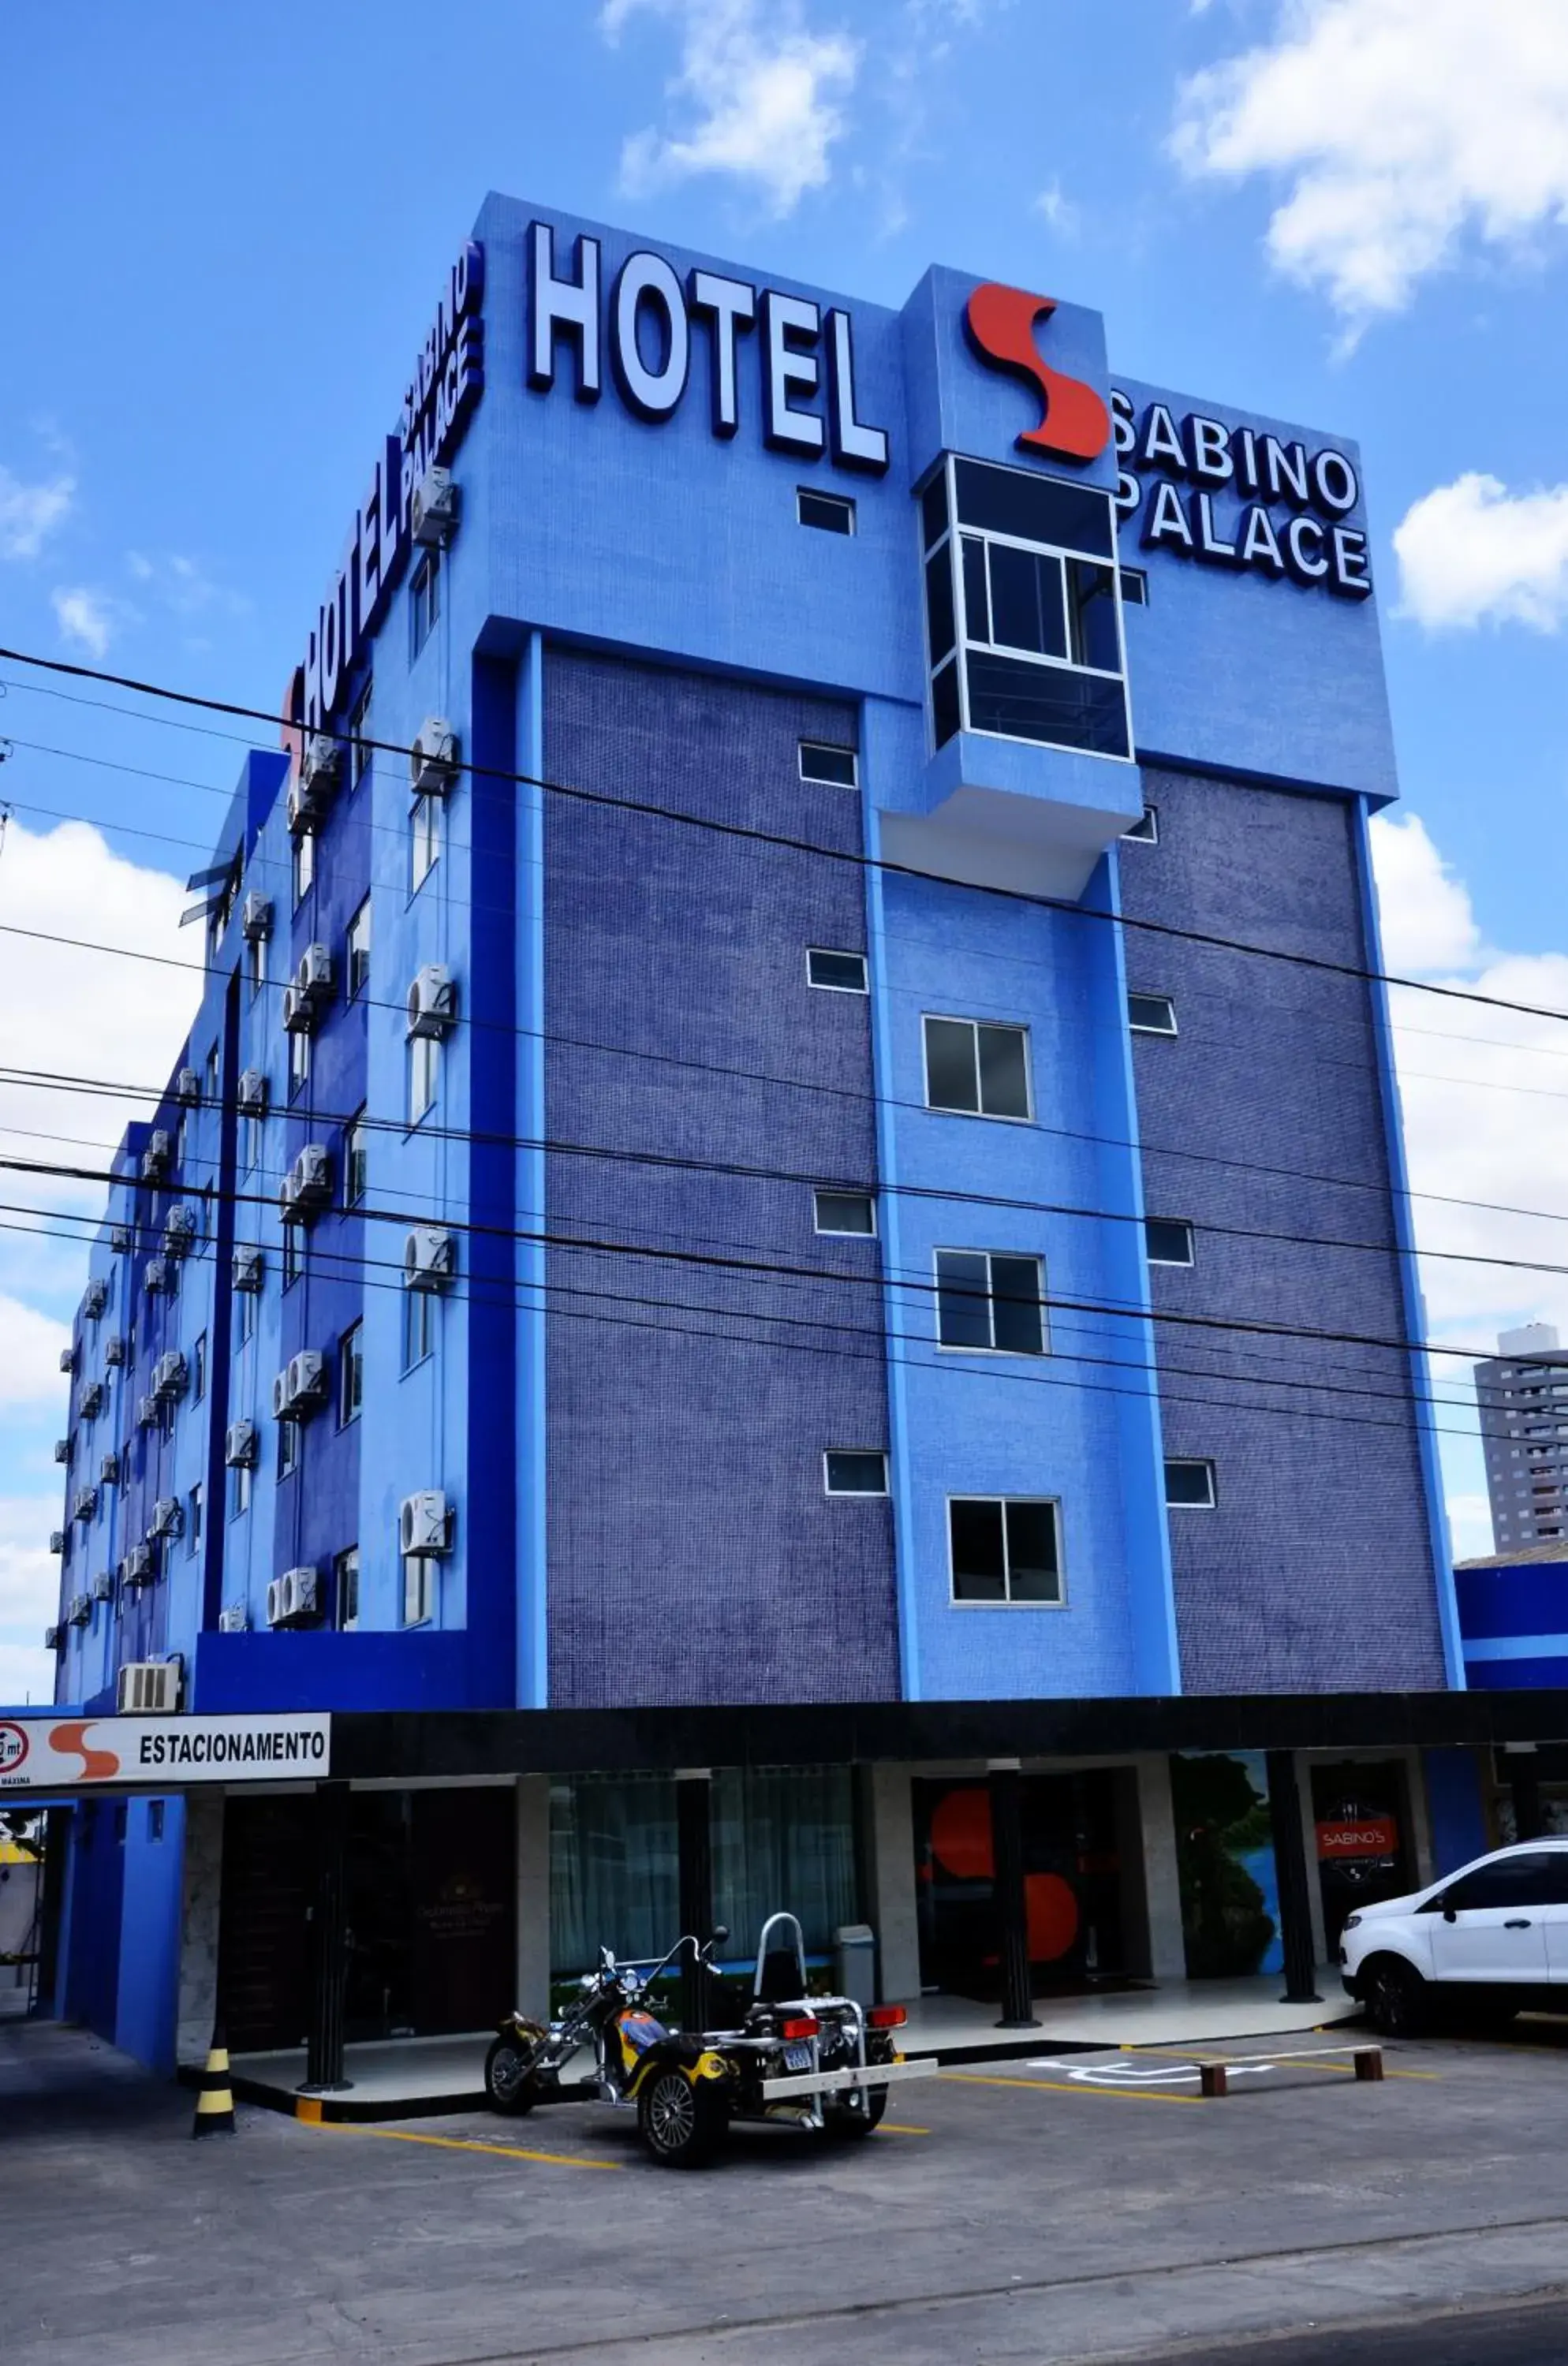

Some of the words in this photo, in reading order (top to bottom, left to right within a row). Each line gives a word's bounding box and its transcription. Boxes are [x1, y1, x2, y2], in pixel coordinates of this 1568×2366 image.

[527, 220, 889, 476] HOTEL
[1110, 387, 1359, 521] SABINO
[1115, 468, 1373, 602] PALACE
[139, 1731, 325, 1764] ESTACIONAMENTO
[1322, 1830, 1386, 1847] SABINO'S
